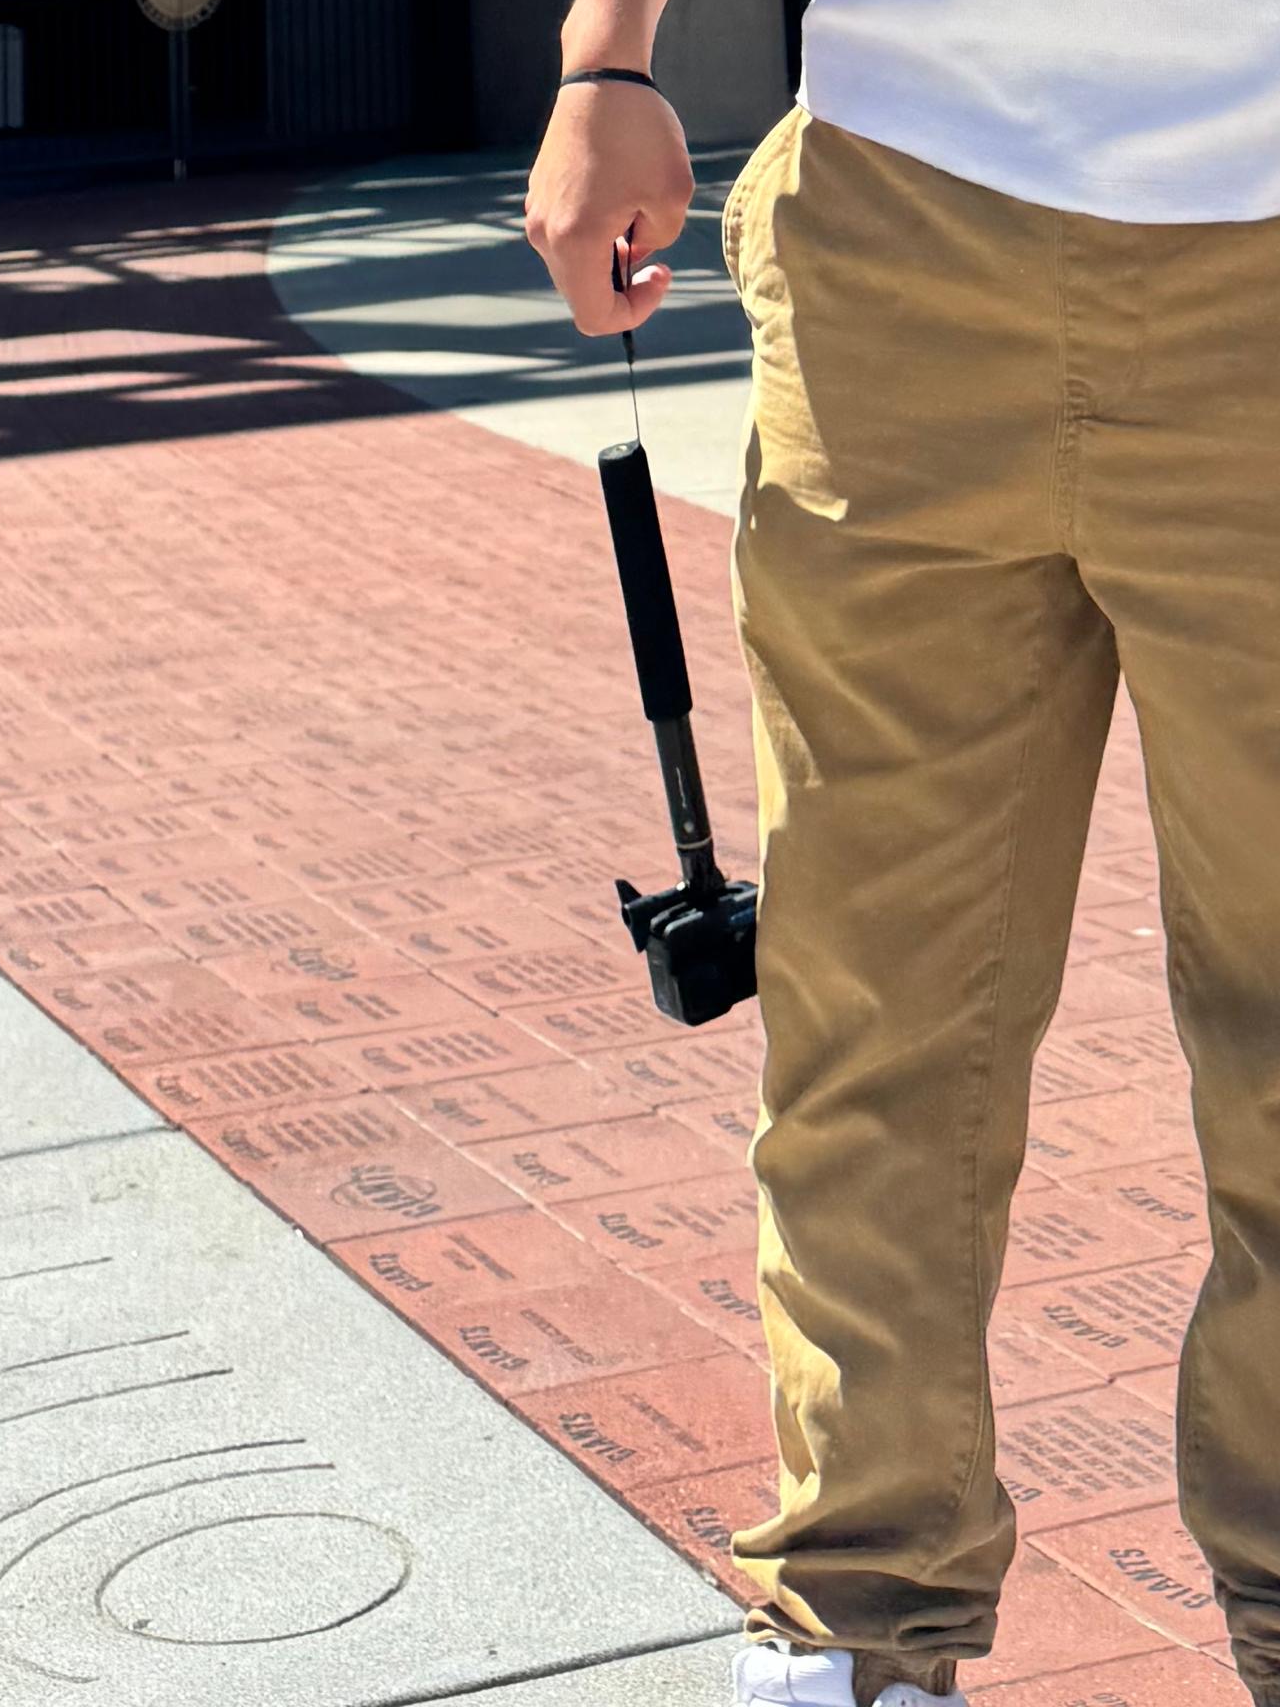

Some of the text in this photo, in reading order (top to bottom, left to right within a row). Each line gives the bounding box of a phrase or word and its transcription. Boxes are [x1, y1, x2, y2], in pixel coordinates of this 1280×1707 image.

[458, 1323, 533, 1369] GIANTS
[1041, 1303, 1129, 1347] GIANTS
[557, 1410, 639, 1461] GIANTS
[1107, 1544, 1215, 1608] GIANTS
